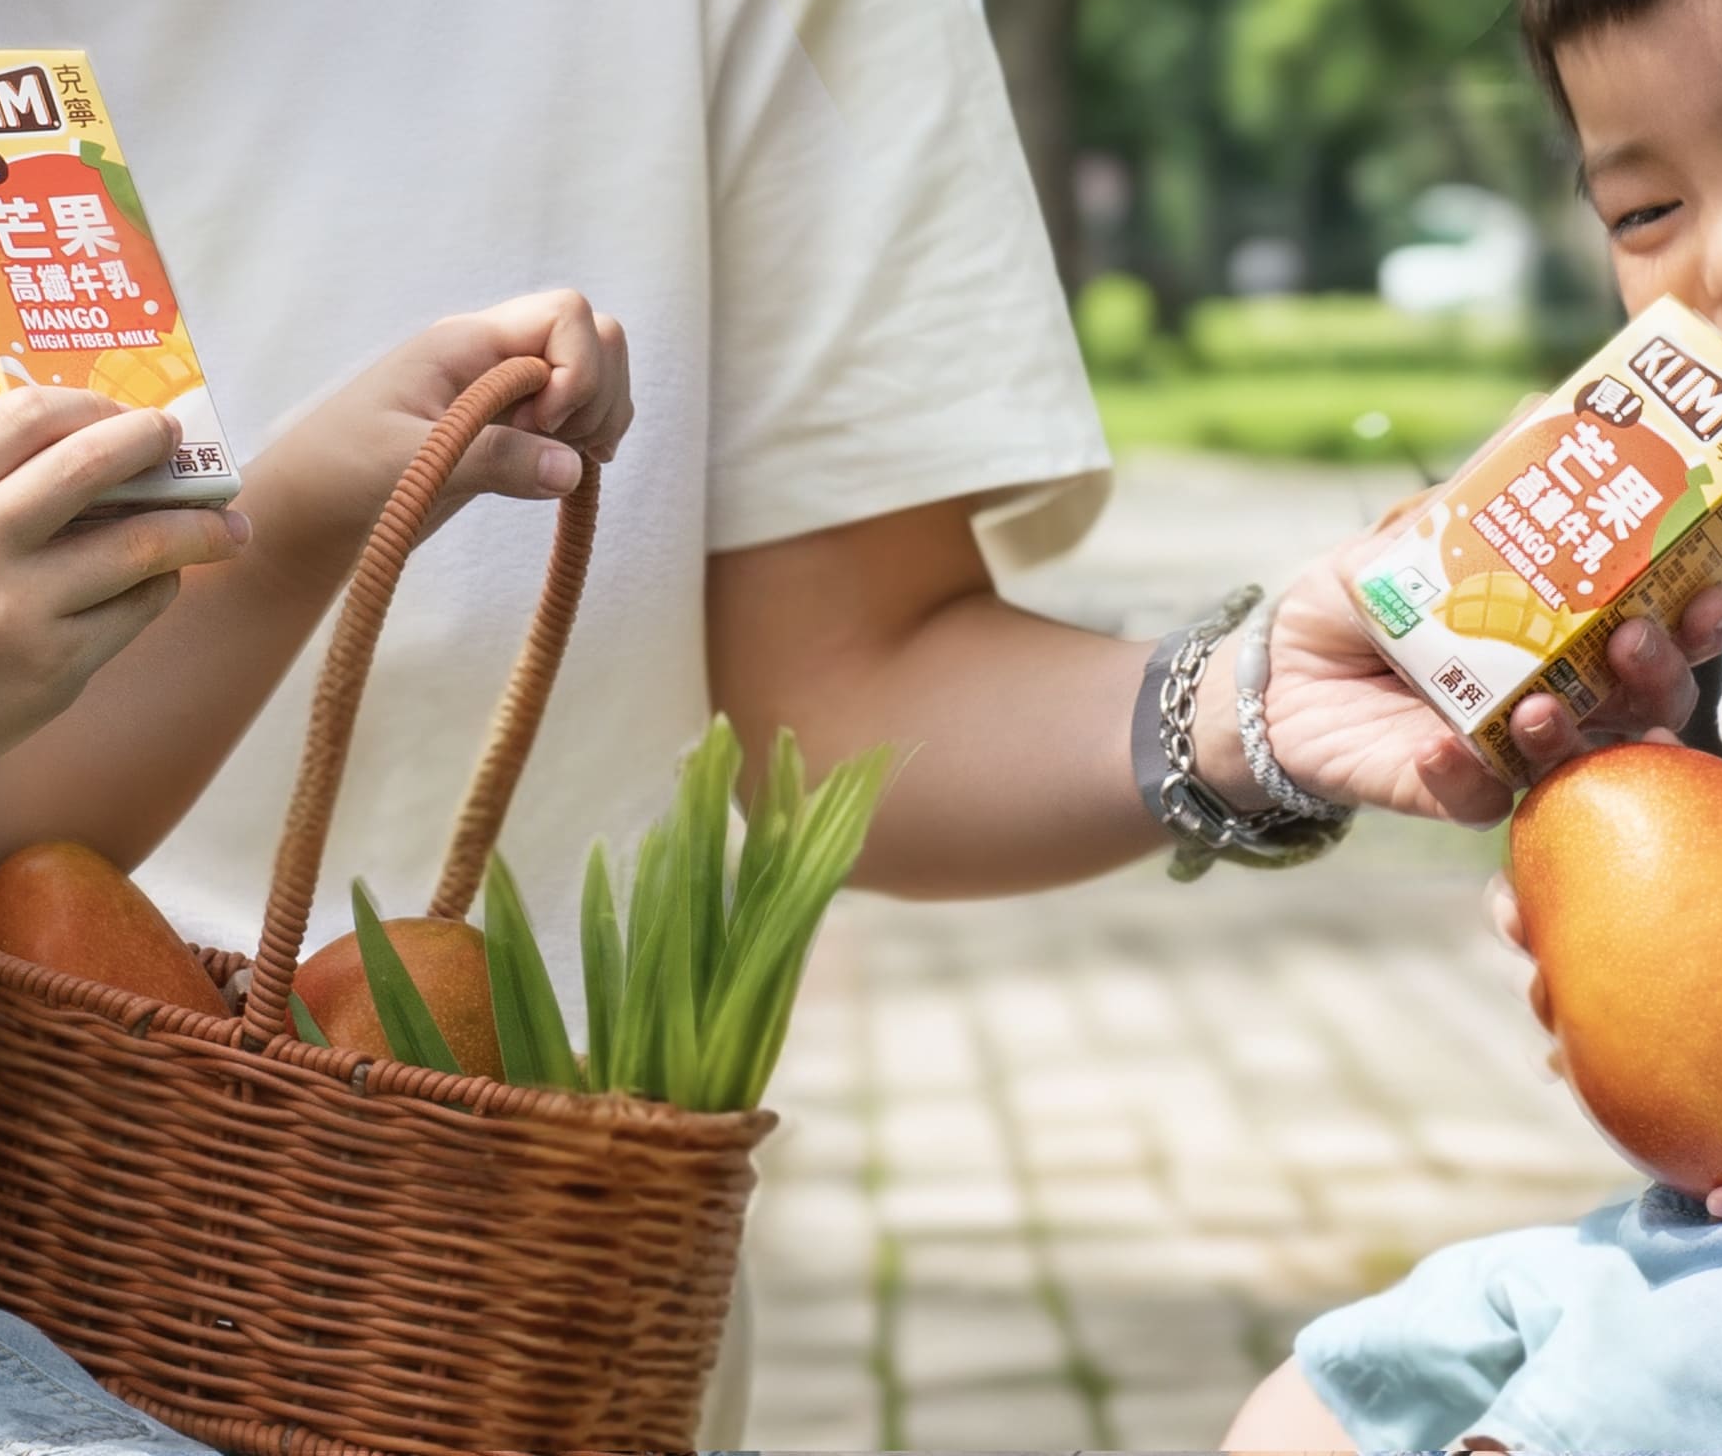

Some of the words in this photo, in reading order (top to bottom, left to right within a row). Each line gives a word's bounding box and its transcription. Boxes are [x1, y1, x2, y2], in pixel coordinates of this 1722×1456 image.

[52, 64, 99, 129] 克寧
[4, 261, 140, 304] 高纖牛乳
[22, 306, 109, 331] MANGO
[29, 333, 70, 349] HIGH
[72, 331, 116, 349] FIBER
[118, 329, 159, 347] MILK
[1586, 380, 1641, 424] 厚!
[174, 448, 223, 474] 高鈣
[1546, 420, 1663, 540] 芒果
[1485, 495, 1557, 566] MANGO
[1508, 464, 1615, 575] 高纖牛乳
[1473, 512, 1507, 550] HIGH
[1501, 540, 1537, 580] FIBER
[1533, 573, 1566, 610] MILK
[1437, 665, 1486, 710] 高鈣
